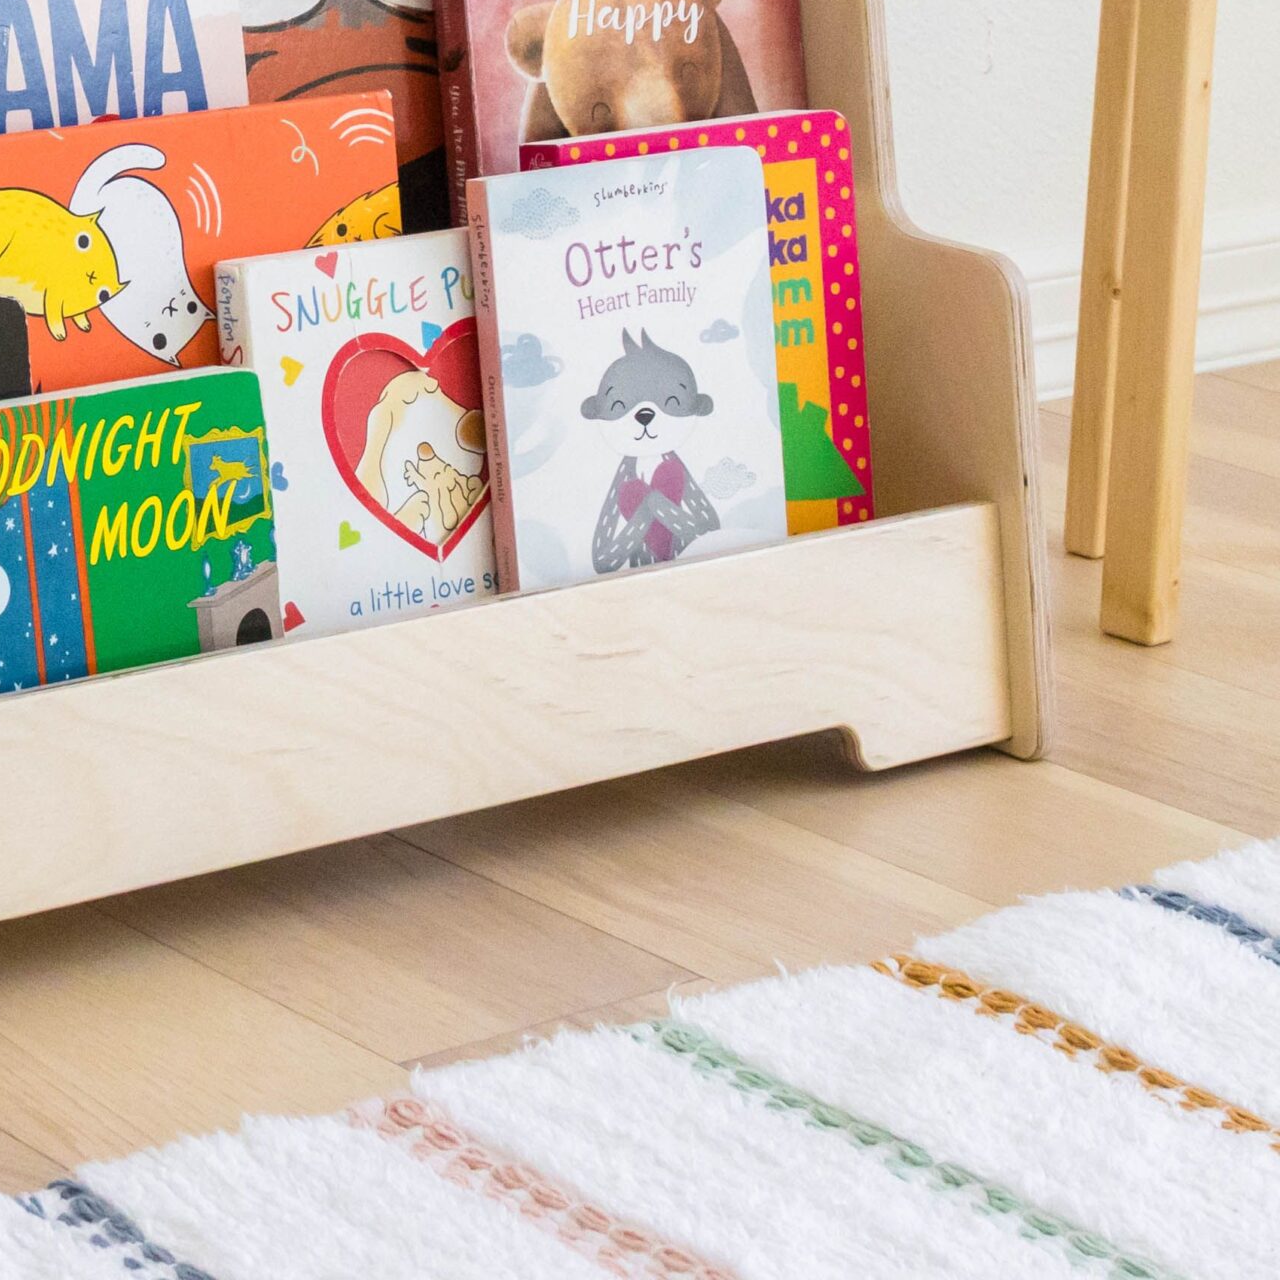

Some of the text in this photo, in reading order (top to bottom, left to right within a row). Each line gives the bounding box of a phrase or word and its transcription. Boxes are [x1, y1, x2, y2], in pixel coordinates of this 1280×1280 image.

[594, 182, 665, 207] slumberkins
[565, 226, 702, 287] Otter's
[218, 274, 238, 341] Boynton
[272, 276, 428, 332] SNUGGLE
[578, 281, 697, 320] Heart Family
[89, 480, 236, 566] MOON
[350, 601, 363, 616] a
[370, 581, 423, 612] little
[431, 575, 475, 600] love
